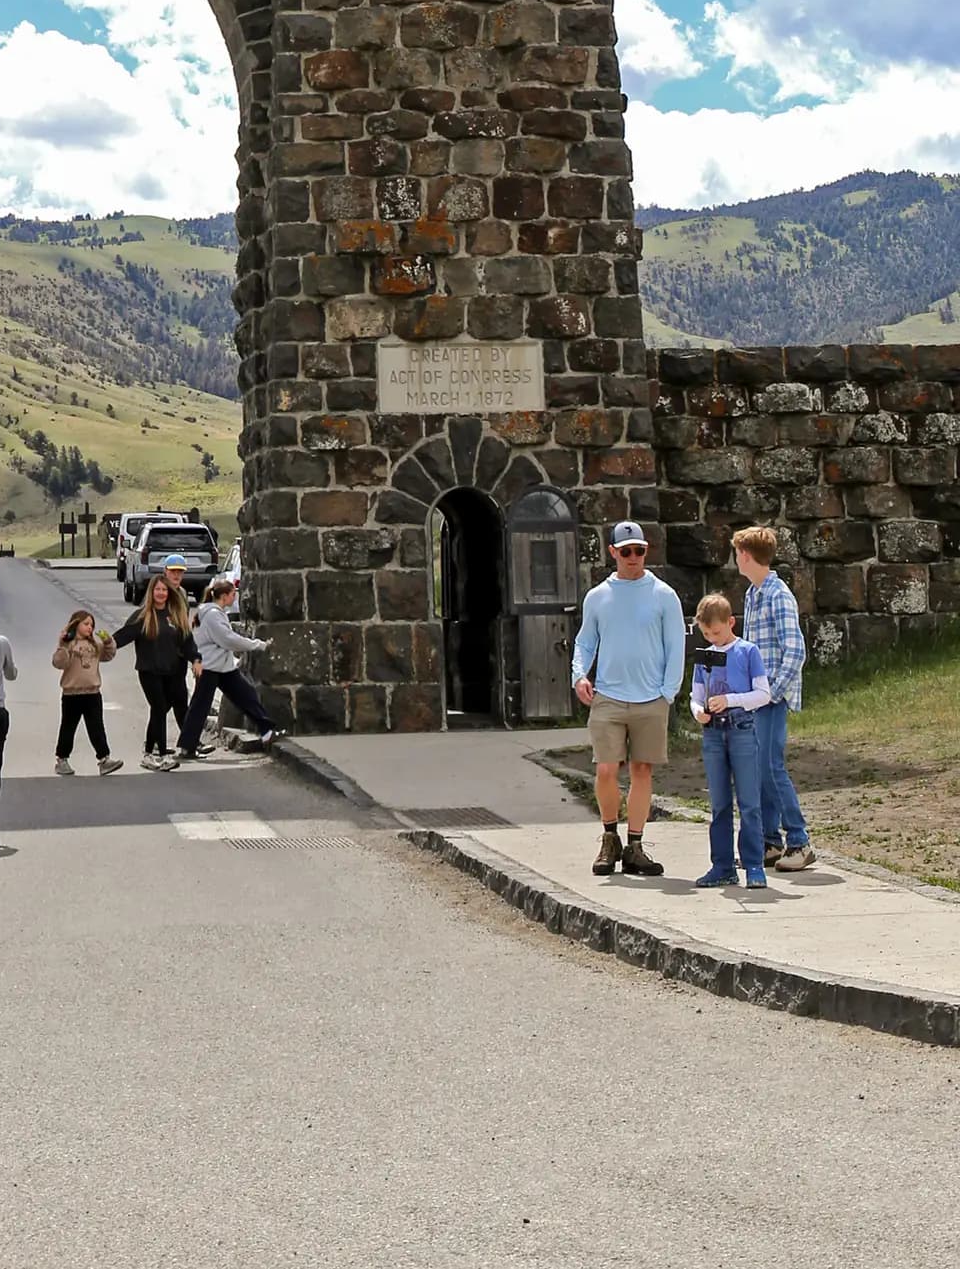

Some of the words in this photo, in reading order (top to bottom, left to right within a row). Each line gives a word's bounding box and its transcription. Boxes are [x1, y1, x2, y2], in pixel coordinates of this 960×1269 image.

[409, 348, 482, 363] CREATED
[490, 348, 511, 362] BY
[390, 370, 417, 384] ACT
[423, 370, 442, 384] OF
[449, 369, 532, 384] CONGRESS
[406, 391, 460, 406] MARCH
